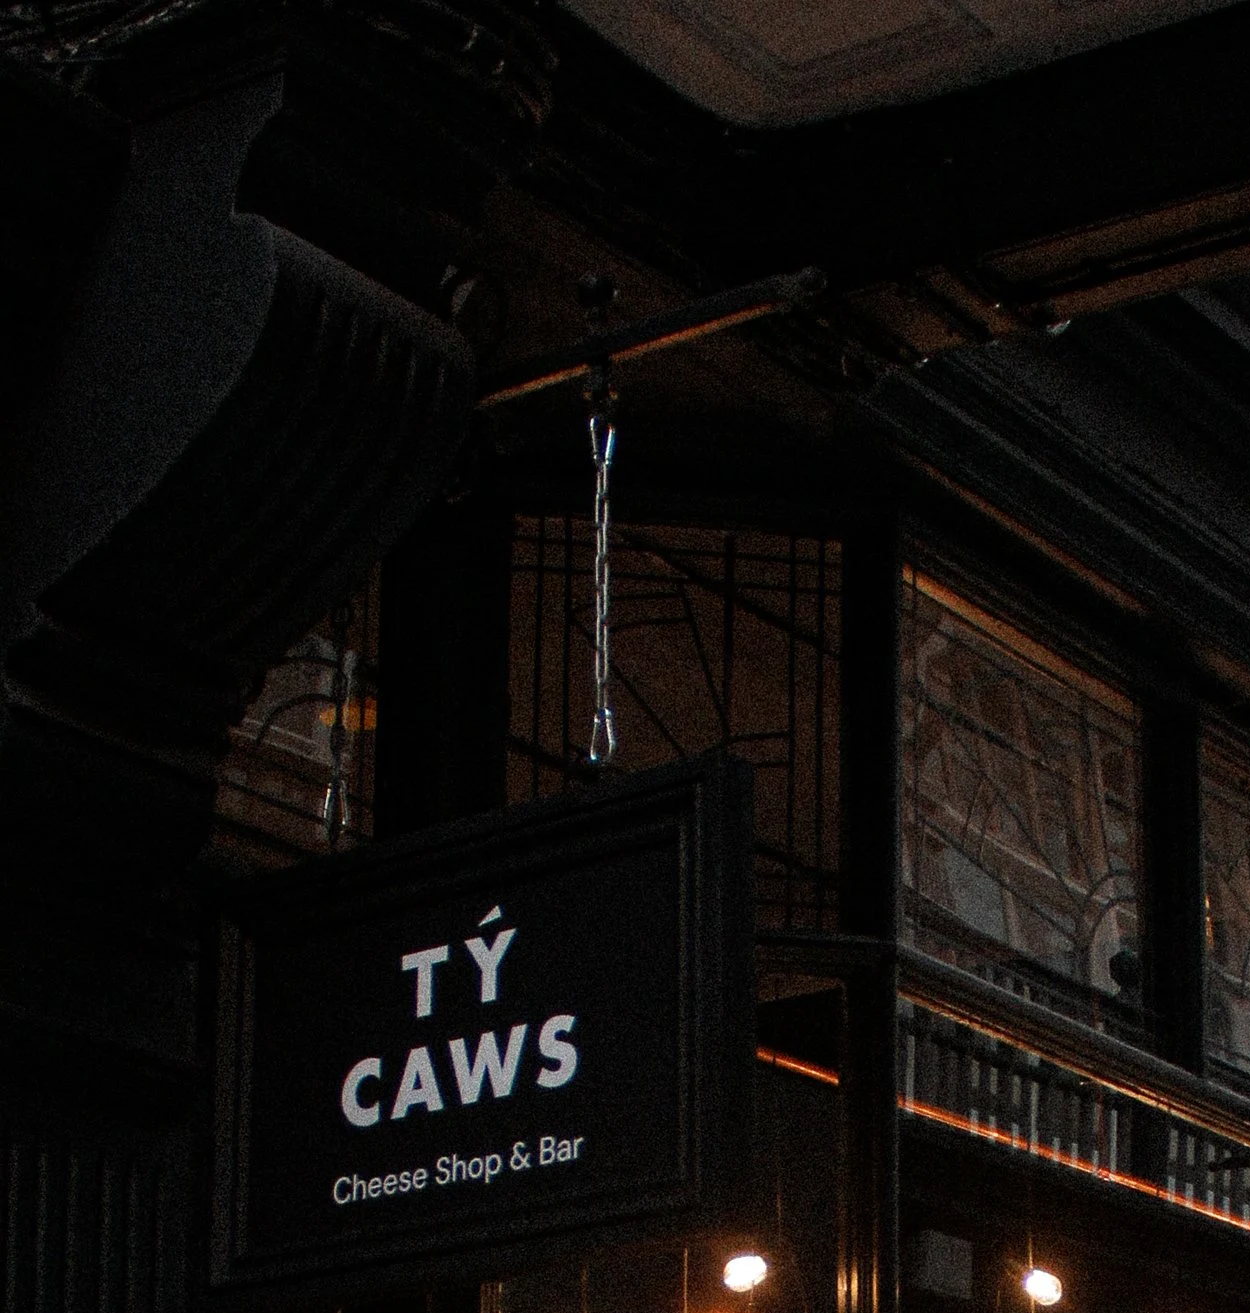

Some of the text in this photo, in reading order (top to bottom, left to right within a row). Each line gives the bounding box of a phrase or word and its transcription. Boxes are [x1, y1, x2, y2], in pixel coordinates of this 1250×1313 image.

[340, 1014, 580, 1128] CAWS
[332, 1132, 585, 1206] Cheese Shop & Bar
